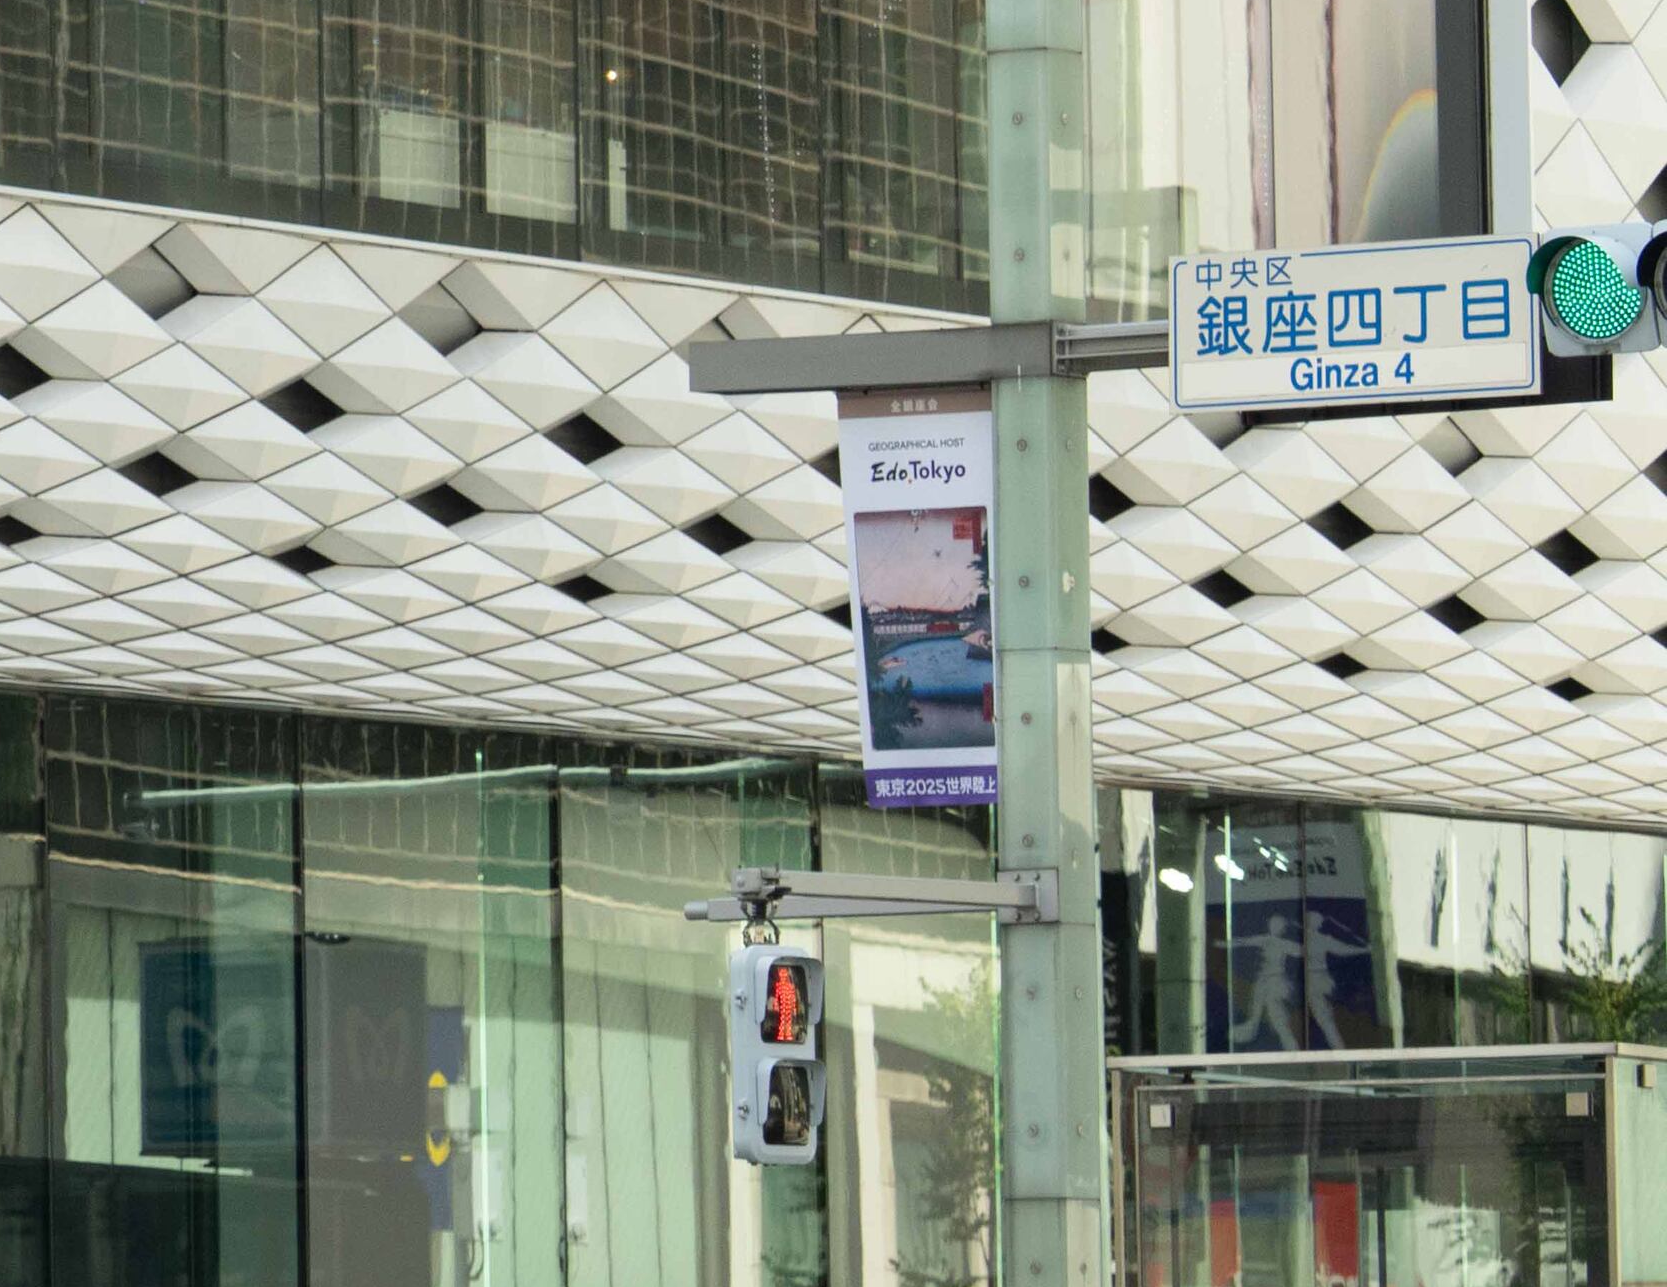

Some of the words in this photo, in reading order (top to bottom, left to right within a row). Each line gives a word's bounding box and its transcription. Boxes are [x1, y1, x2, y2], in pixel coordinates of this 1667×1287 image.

[1195, 256, 1294, 292] 中央区
[1196, 277, 1512, 358] 銀座四丁目
[1289, 356, 1380, 392] Ginza
[1393, 352, 1415, 385] 4
[868, 439, 938, 452] GEOGRAPHICAL
[940, 437, 965, 448] HOST
[874, 775, 997, 798] 東京2025世界陸上
